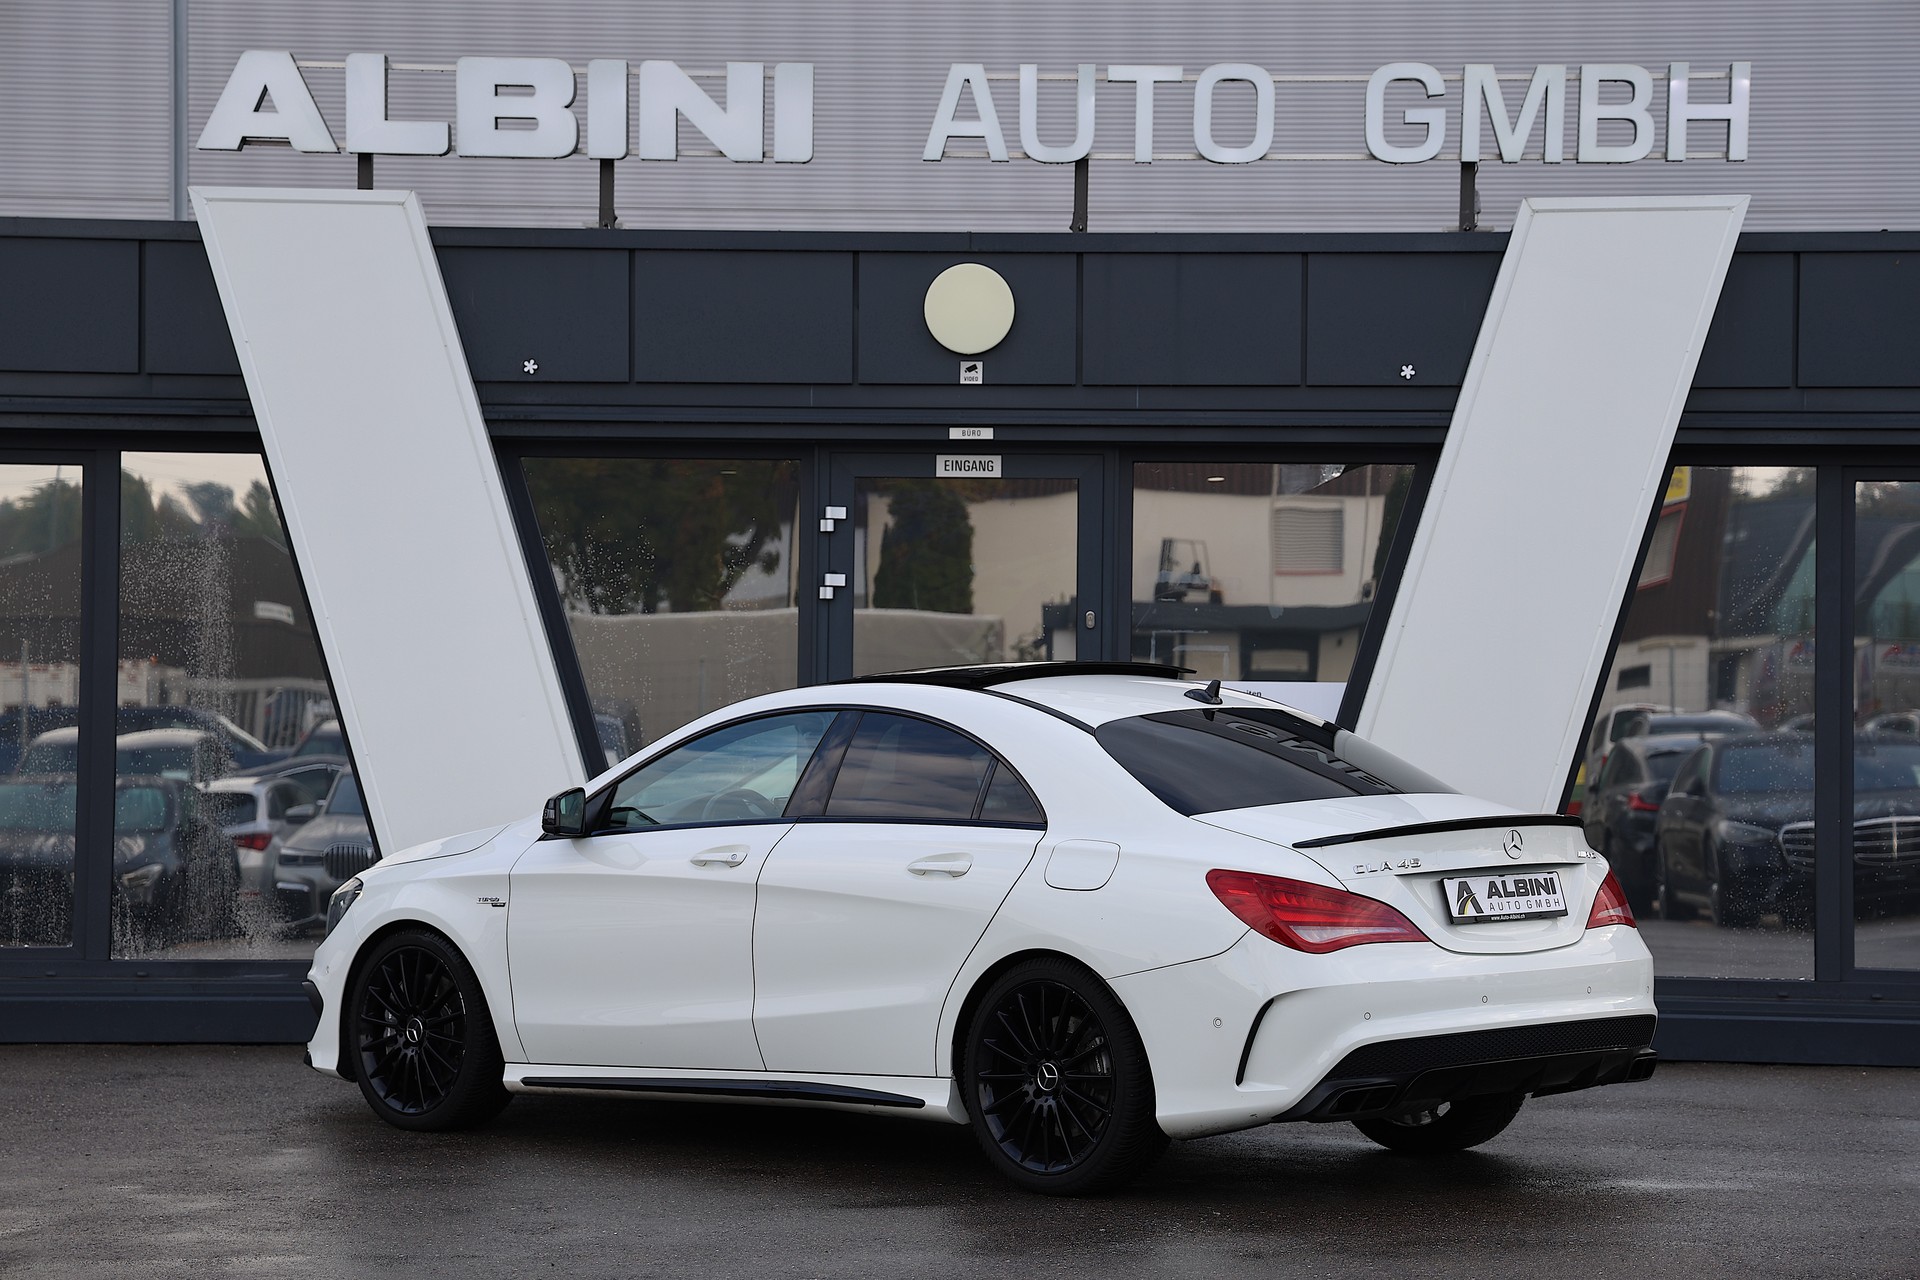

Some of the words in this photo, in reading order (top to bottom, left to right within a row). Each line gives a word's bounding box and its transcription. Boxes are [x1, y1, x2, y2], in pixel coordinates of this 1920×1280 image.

[195, 49, 814, 163] ALBINI
[922, 62, 1276, 164] AUTO
[1364, 60, 1752, 164] GMBH
[961, 429, 982, 437] BÜRO
[944, 459, 994, 472] EINGANG
[1353, 861, 1393, 875] CLA
[1397, 857, 1422, 869] 45
[1487, 877, 1557, 899] ALBINI
[1489, 900, 1521, 912] AUTO
[1526, 897, 1560, 910] GMBH
